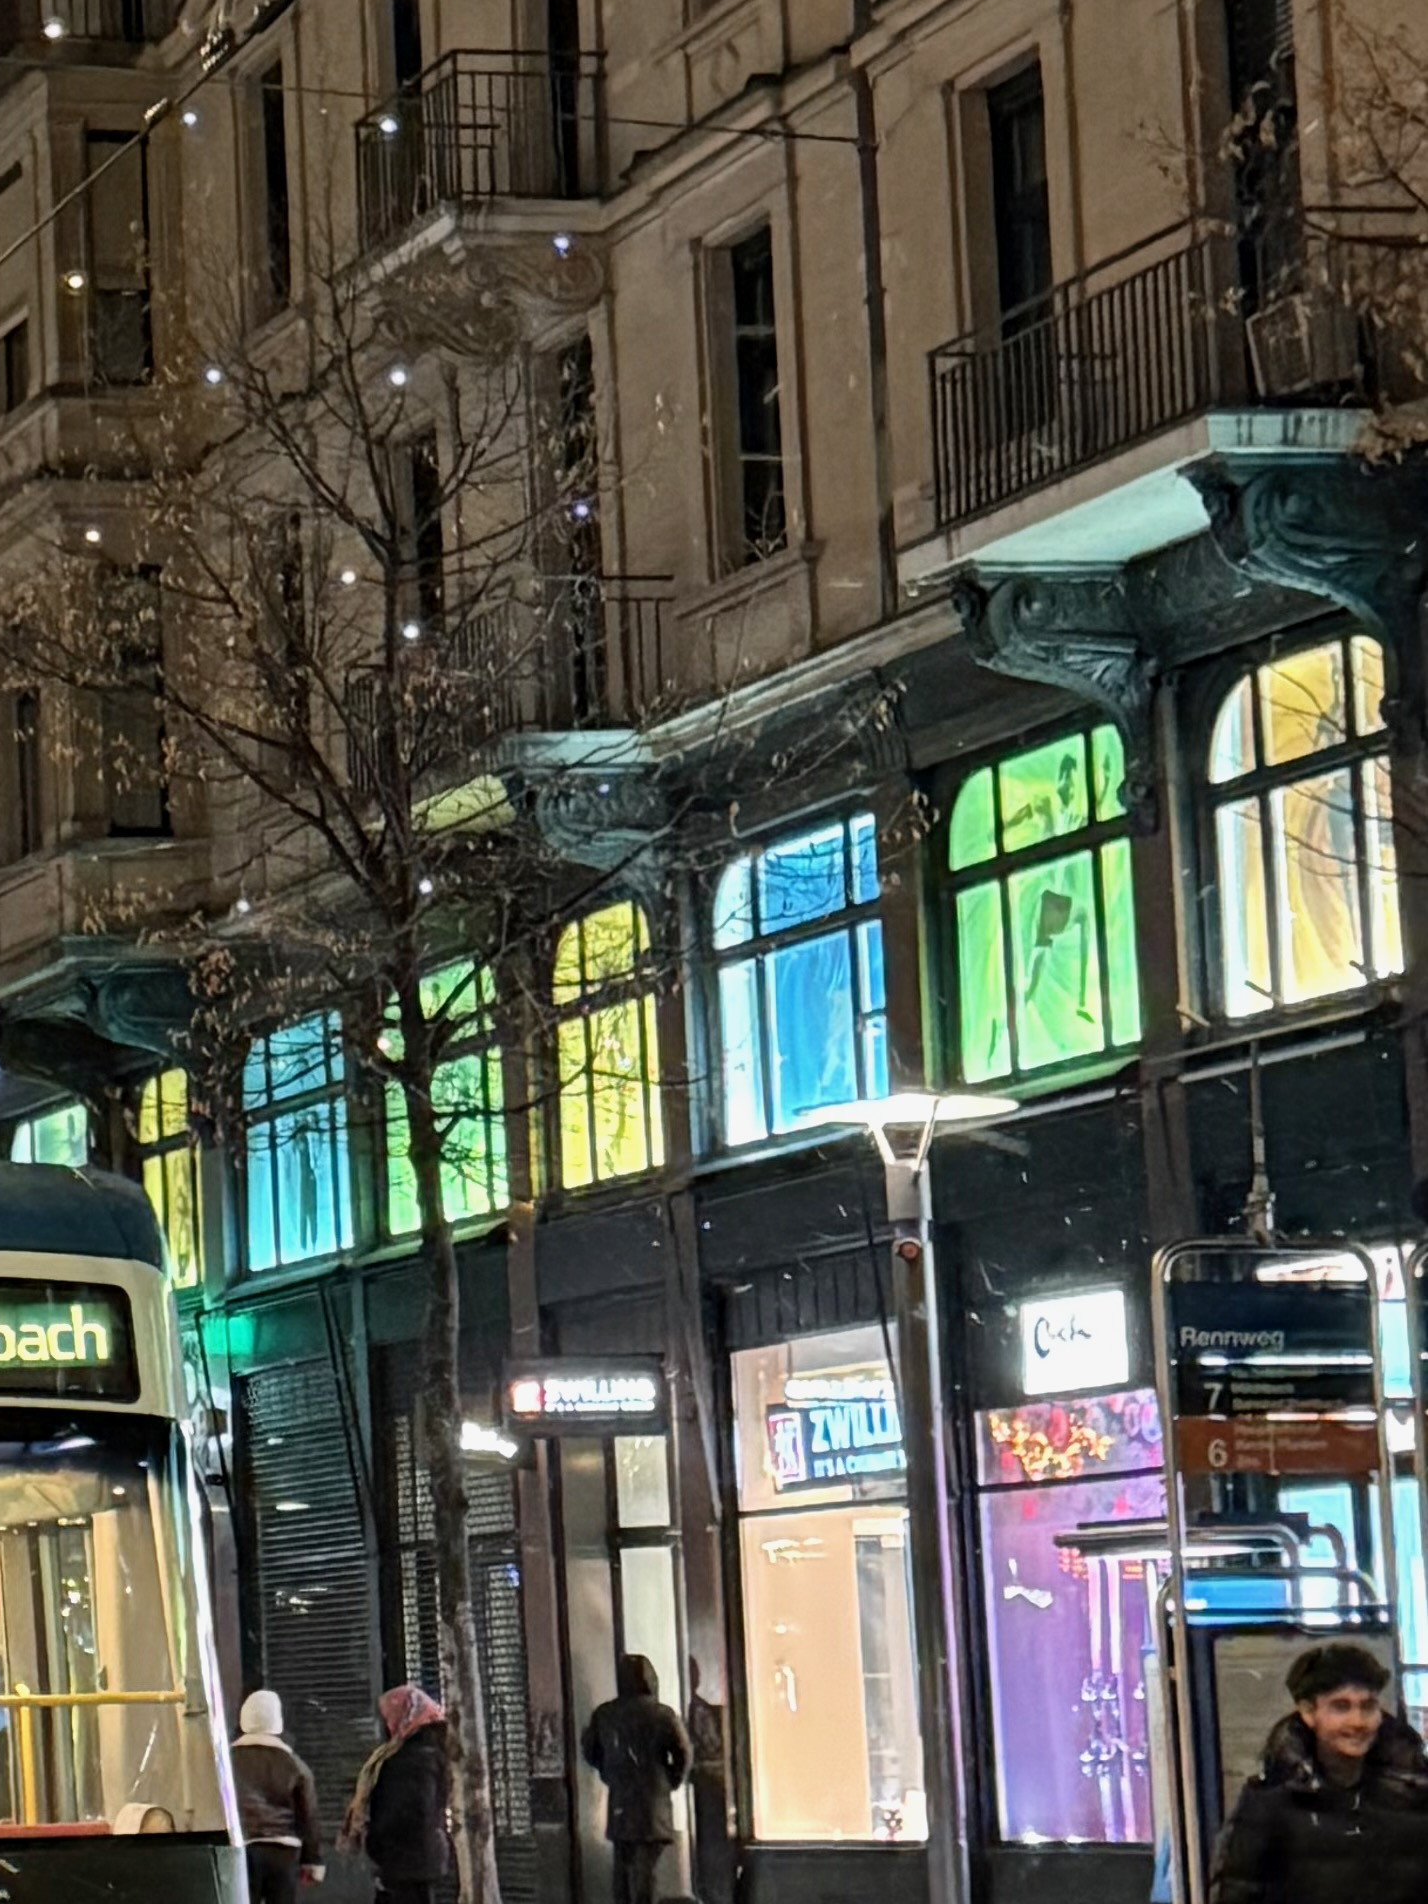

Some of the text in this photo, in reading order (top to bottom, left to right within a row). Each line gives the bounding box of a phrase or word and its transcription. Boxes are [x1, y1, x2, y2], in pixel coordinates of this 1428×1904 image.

[1179, 1326, 1285, 1352] Rennweg
[1202, 1381, 1224, 1412] 7
[1207, 1438, 1228, 1468] 6
